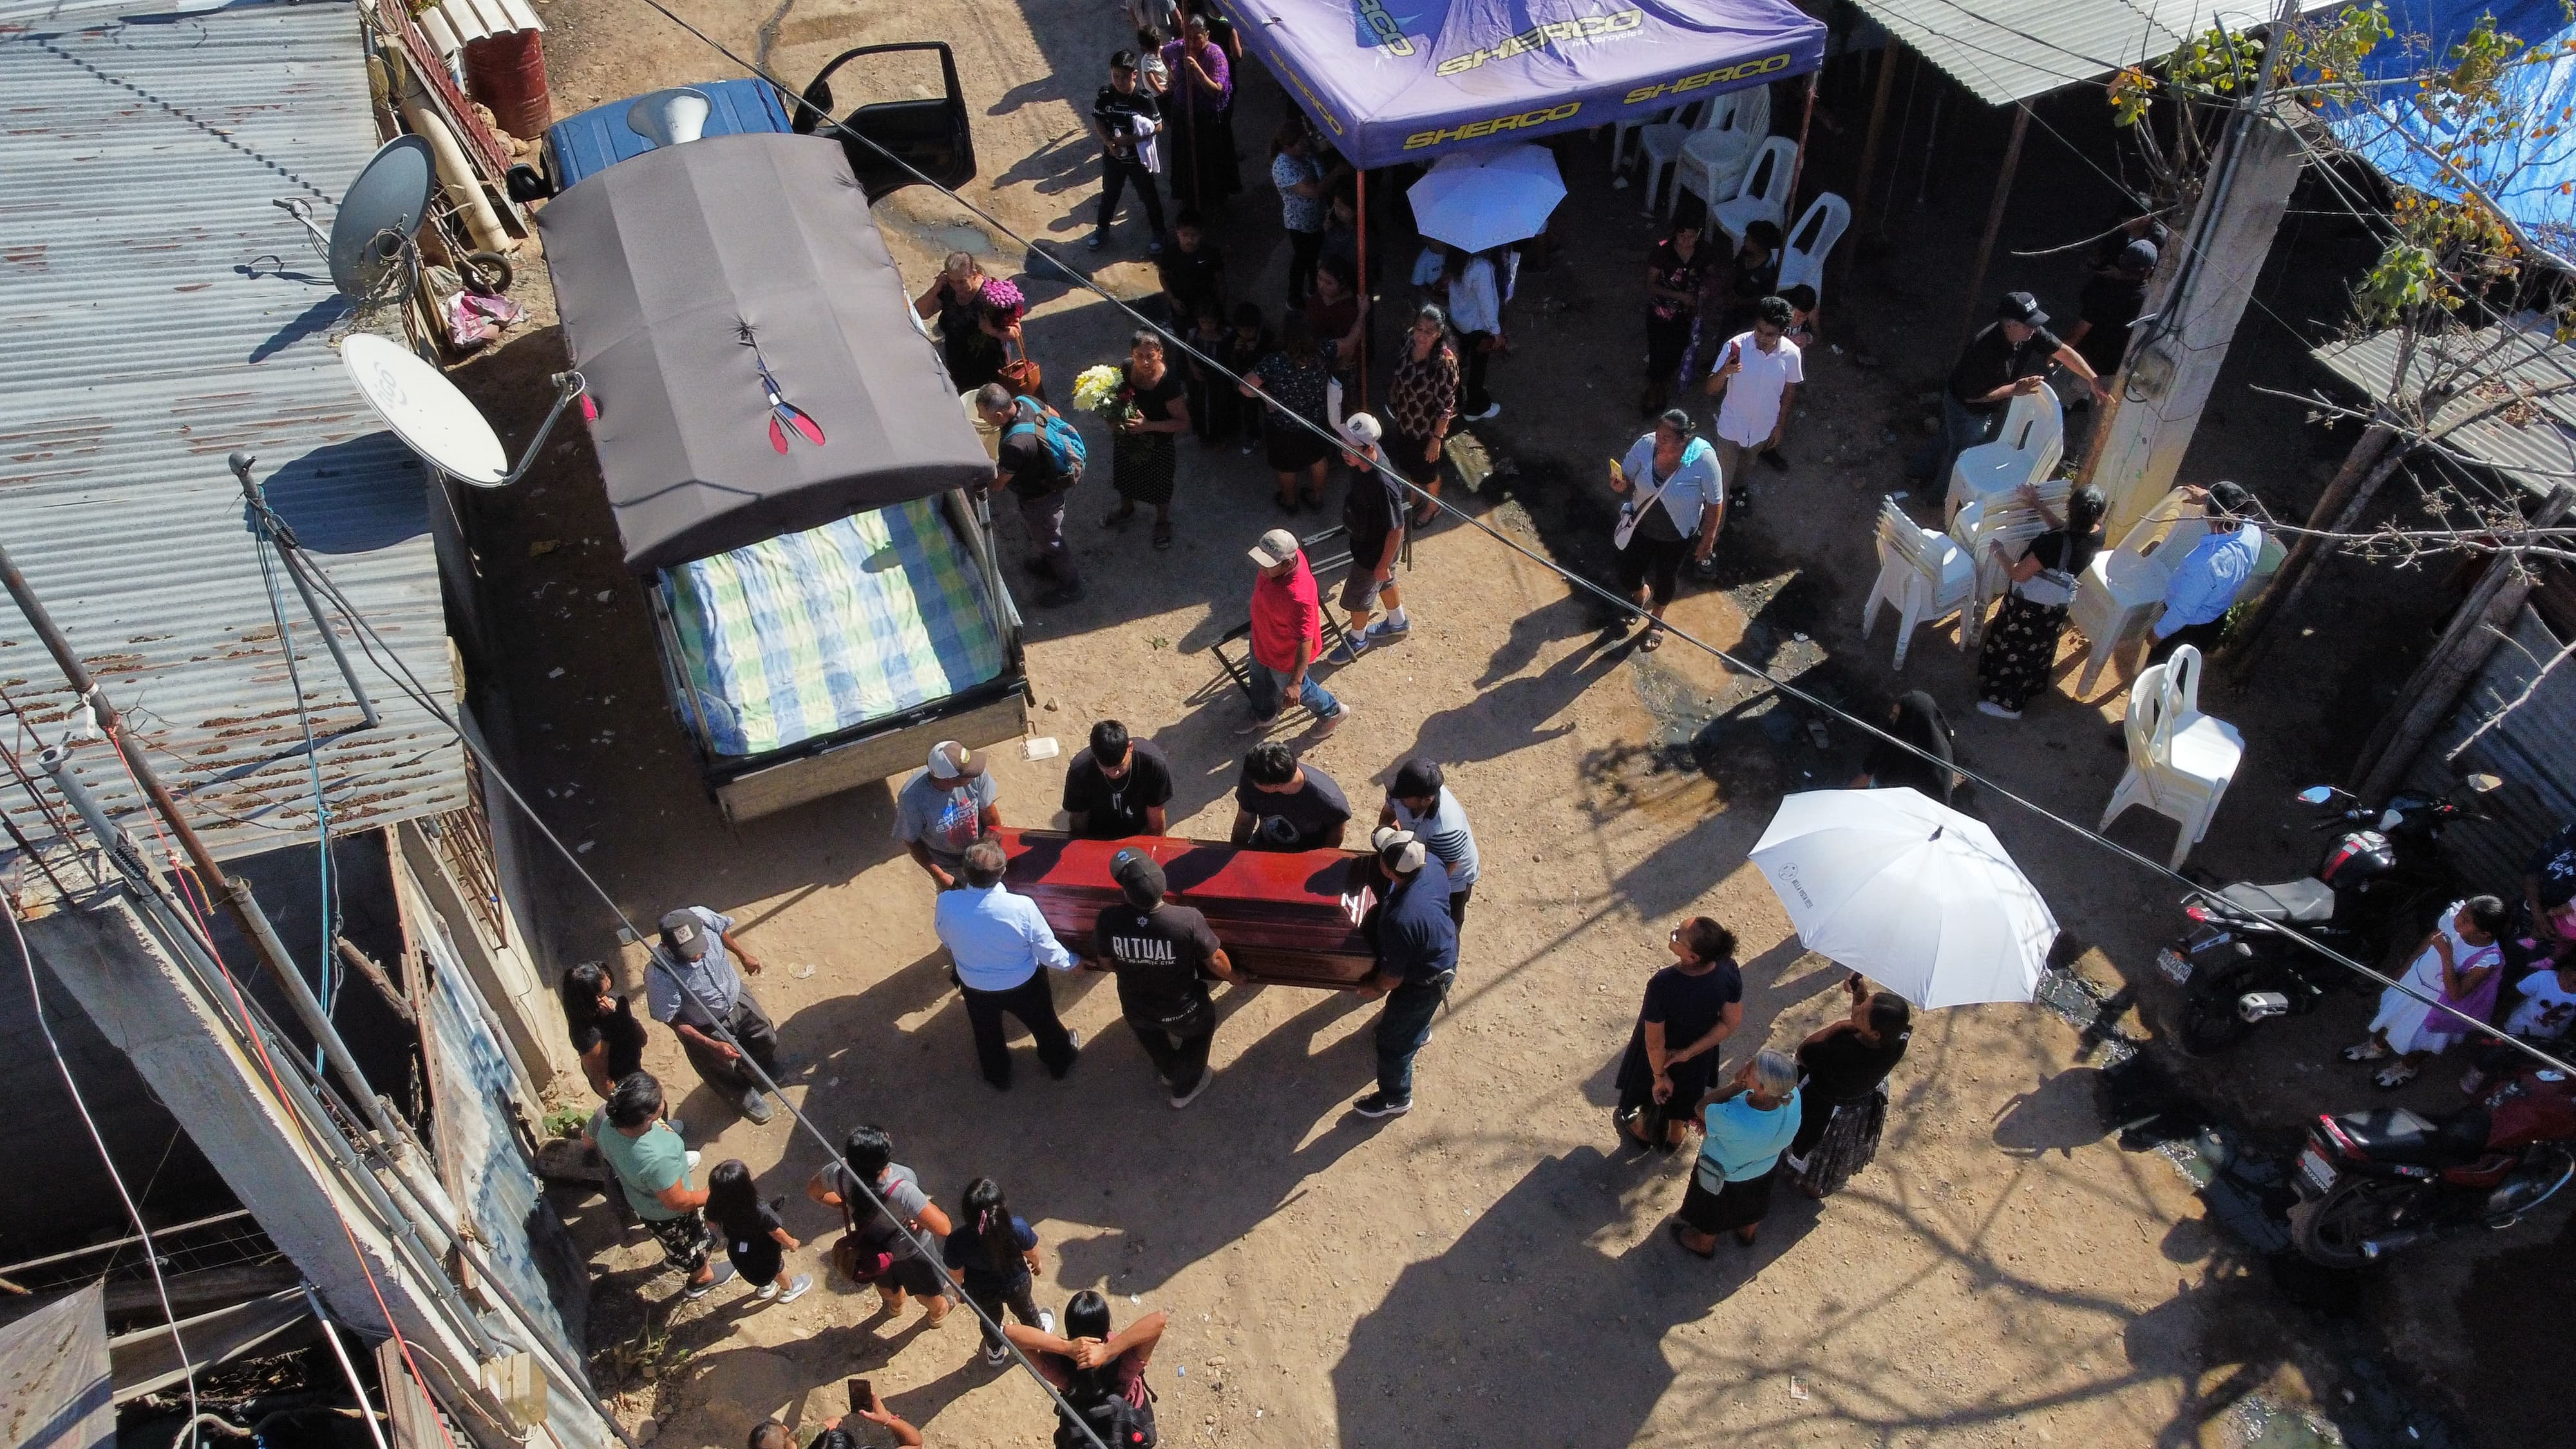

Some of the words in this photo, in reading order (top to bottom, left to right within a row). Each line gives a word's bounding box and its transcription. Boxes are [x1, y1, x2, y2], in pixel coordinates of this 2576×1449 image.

[1435, 8, 1643, 77] SHERCO
[1572, 28, 1644, 47] Motorcycles
[1624, 54, 1791, 104] SHERCO
[1403, 101, 1583, 151] SHERCO
[1113, 936, 1177, 961] RITUAL
